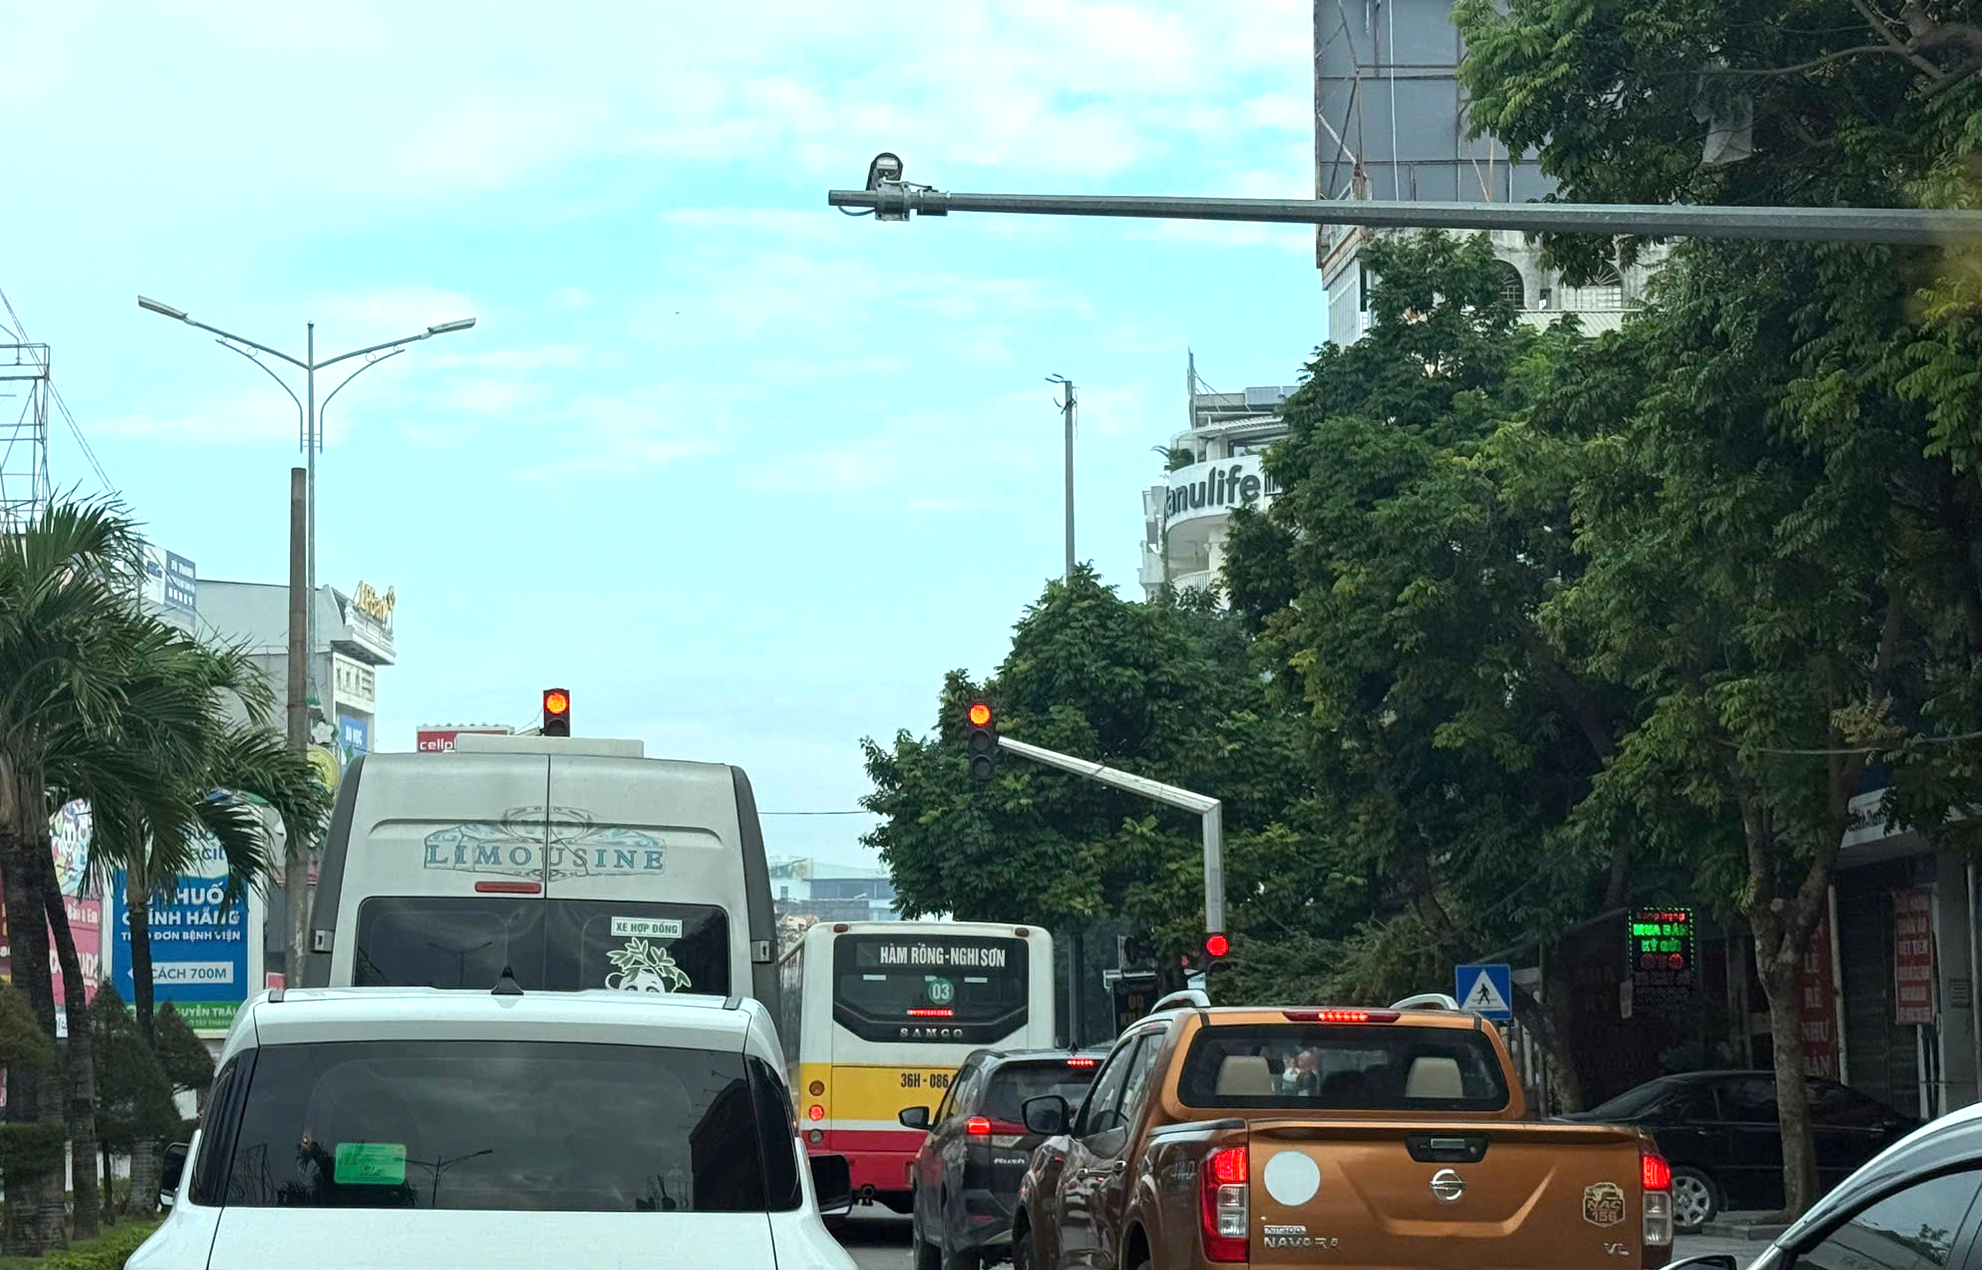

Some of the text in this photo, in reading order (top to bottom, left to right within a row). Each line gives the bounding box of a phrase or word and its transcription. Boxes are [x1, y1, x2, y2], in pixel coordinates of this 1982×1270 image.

[1165, 464, 1261, 519] anulife
[428, 844, 663, 870] LIMOUSINE
[122, 908, 181, 926] CÍNH
[616, 921, 678, 935] XE HỢP ĐỒNG
[154, 931, 180, 941] ĐƠN
[183, 930, 212, 942] BỆNH
[214, 930, 241, 942] VIỆN
[880, 943, 908, 964] HÀM
[980, 948, 1006, 968] SƠN
[152, 966, 227, 979] CÁCH 700M
[931, 982, 950, 1000] 03
[900, 1027, 963, 1038] SAMCO
[900, 1073, 920, 1088] 36H
[1264, 1236, 1340, 1249] NAVARA
